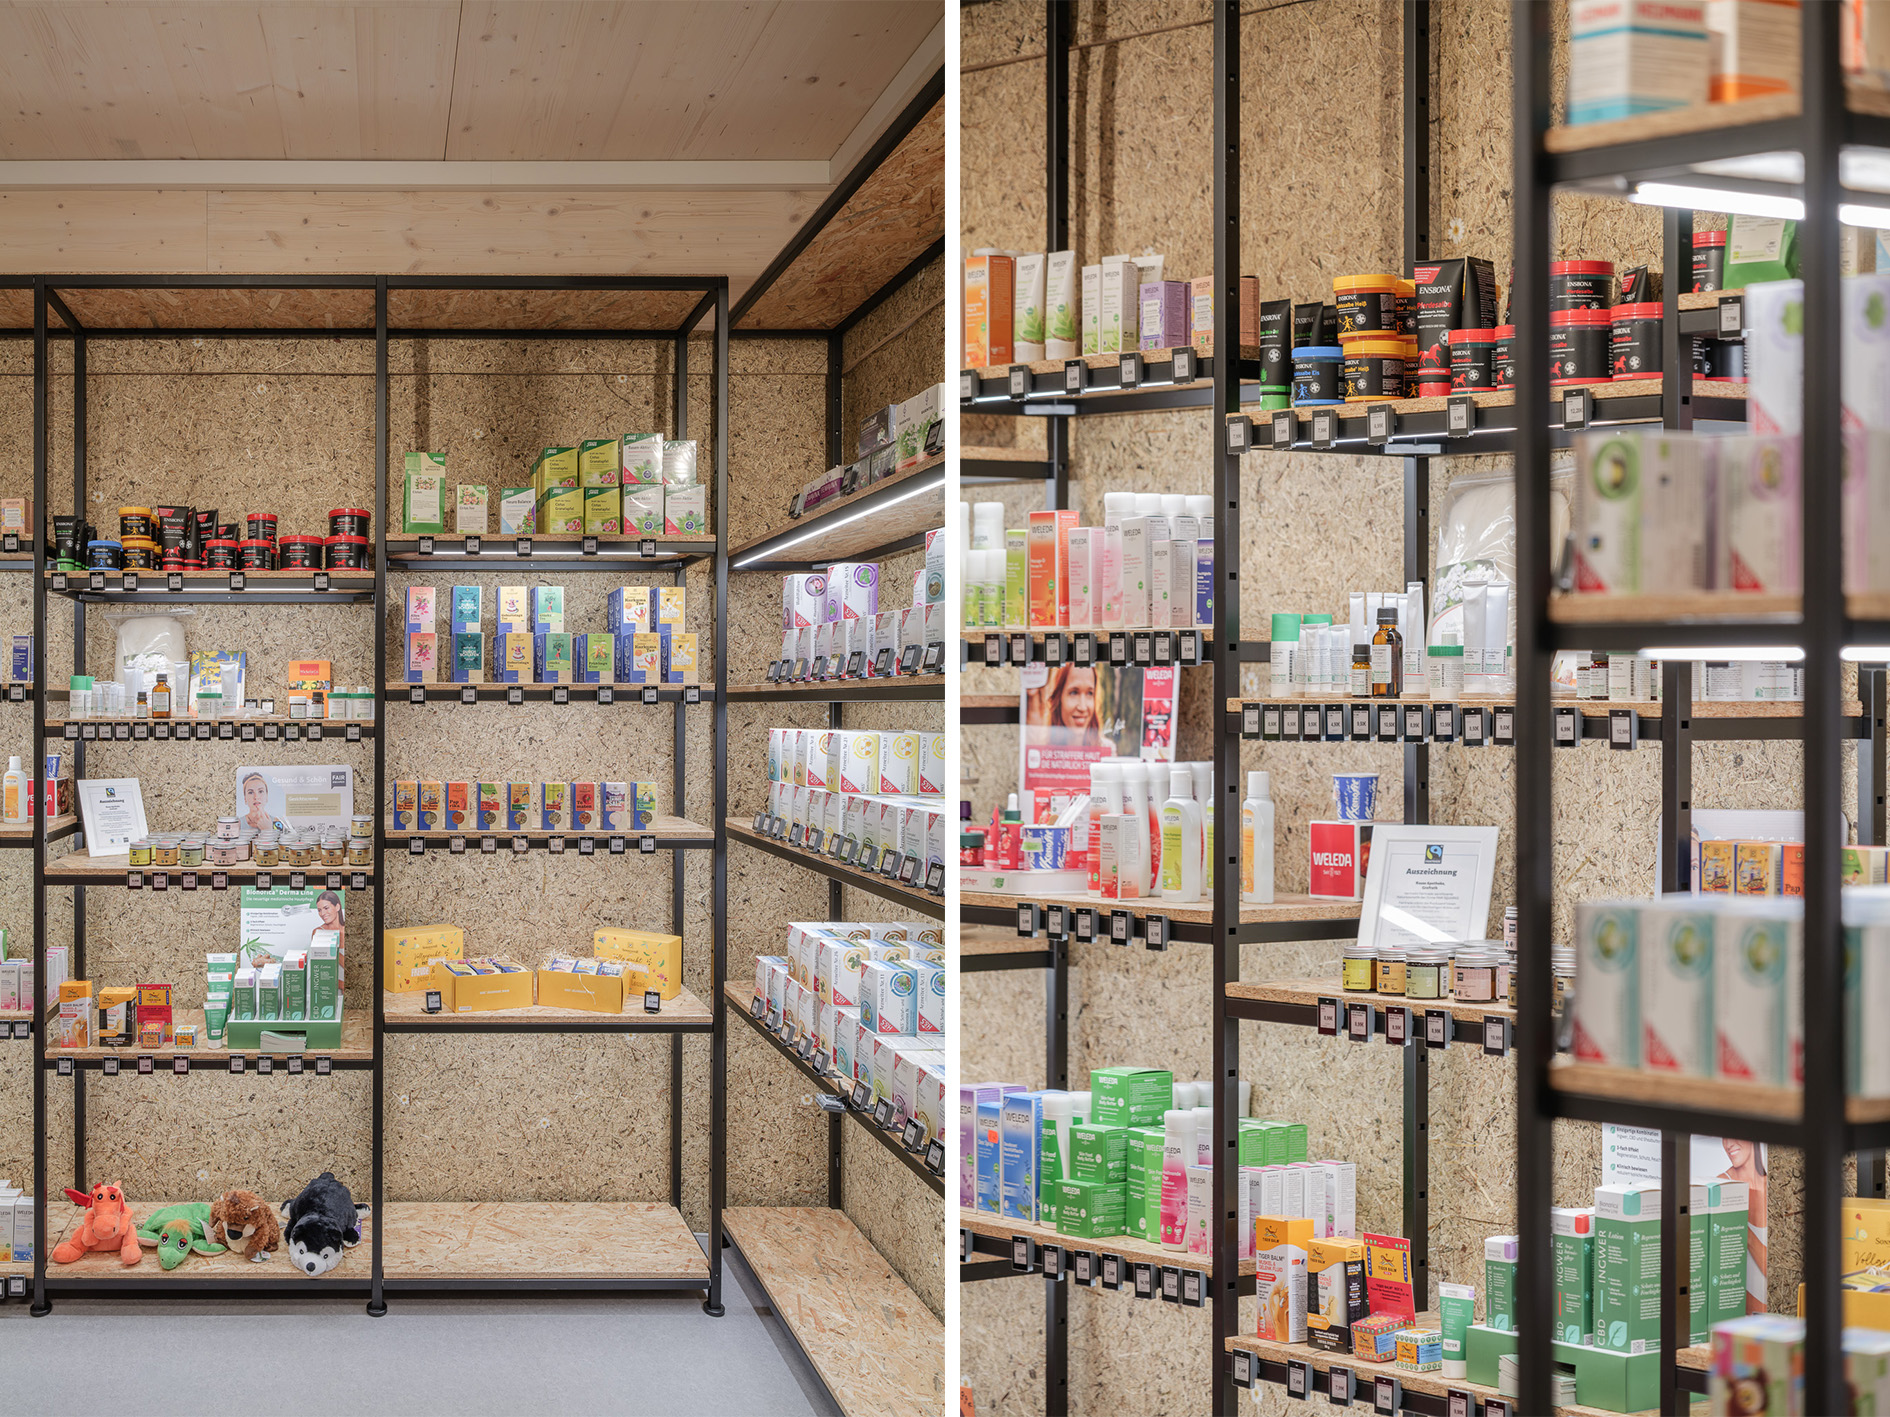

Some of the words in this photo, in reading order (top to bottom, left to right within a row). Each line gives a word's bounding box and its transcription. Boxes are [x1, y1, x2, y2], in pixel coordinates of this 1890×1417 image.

[1419, 285, 1452, 294] ENSBONA
[1417, 300, 1452, 310] Pferdesalbe
[1032, 525, 1053, 534] WELEDA
[1146, 670, 1172, 680] WELEDA
[272, 776, 298, 784] Gesund
[809, 774, 820, 785] H&S
[842, 780, 854, 791] H&S
[882, 780, 894, 791] H&S
[920, 780, 932, 791] H&S
[1312, 852, 1352, 867] WELEDA
[1406, 868, 1458, 877] Auszeichnung
[1785, 884, 1800, 894] Pap
[411, 967, 430, 977] FREUDE
[834, 993, 846, 1004] H&S
[880, 1020, 893, 1031] H&S
[920, 1019, 932, 1031] H&S
[1098, 1076, 1118, 1084] WELEDA
[1006, 1112, 1030, 1123] WELEDA
[980, 1118, 998, 1128] WELEDA
[1076, 1132, 1096, 1141] WELEDA
[1062, 1186, 1080, 1195] WELEDA
[1608, 1232, 1624, 1240] Lotion
[1598, 1230, 1606, 1283] INGWER
[1556, 1242, 1564, 1286] INGWER
[1597, 1319, 1606, 1346] CBD
